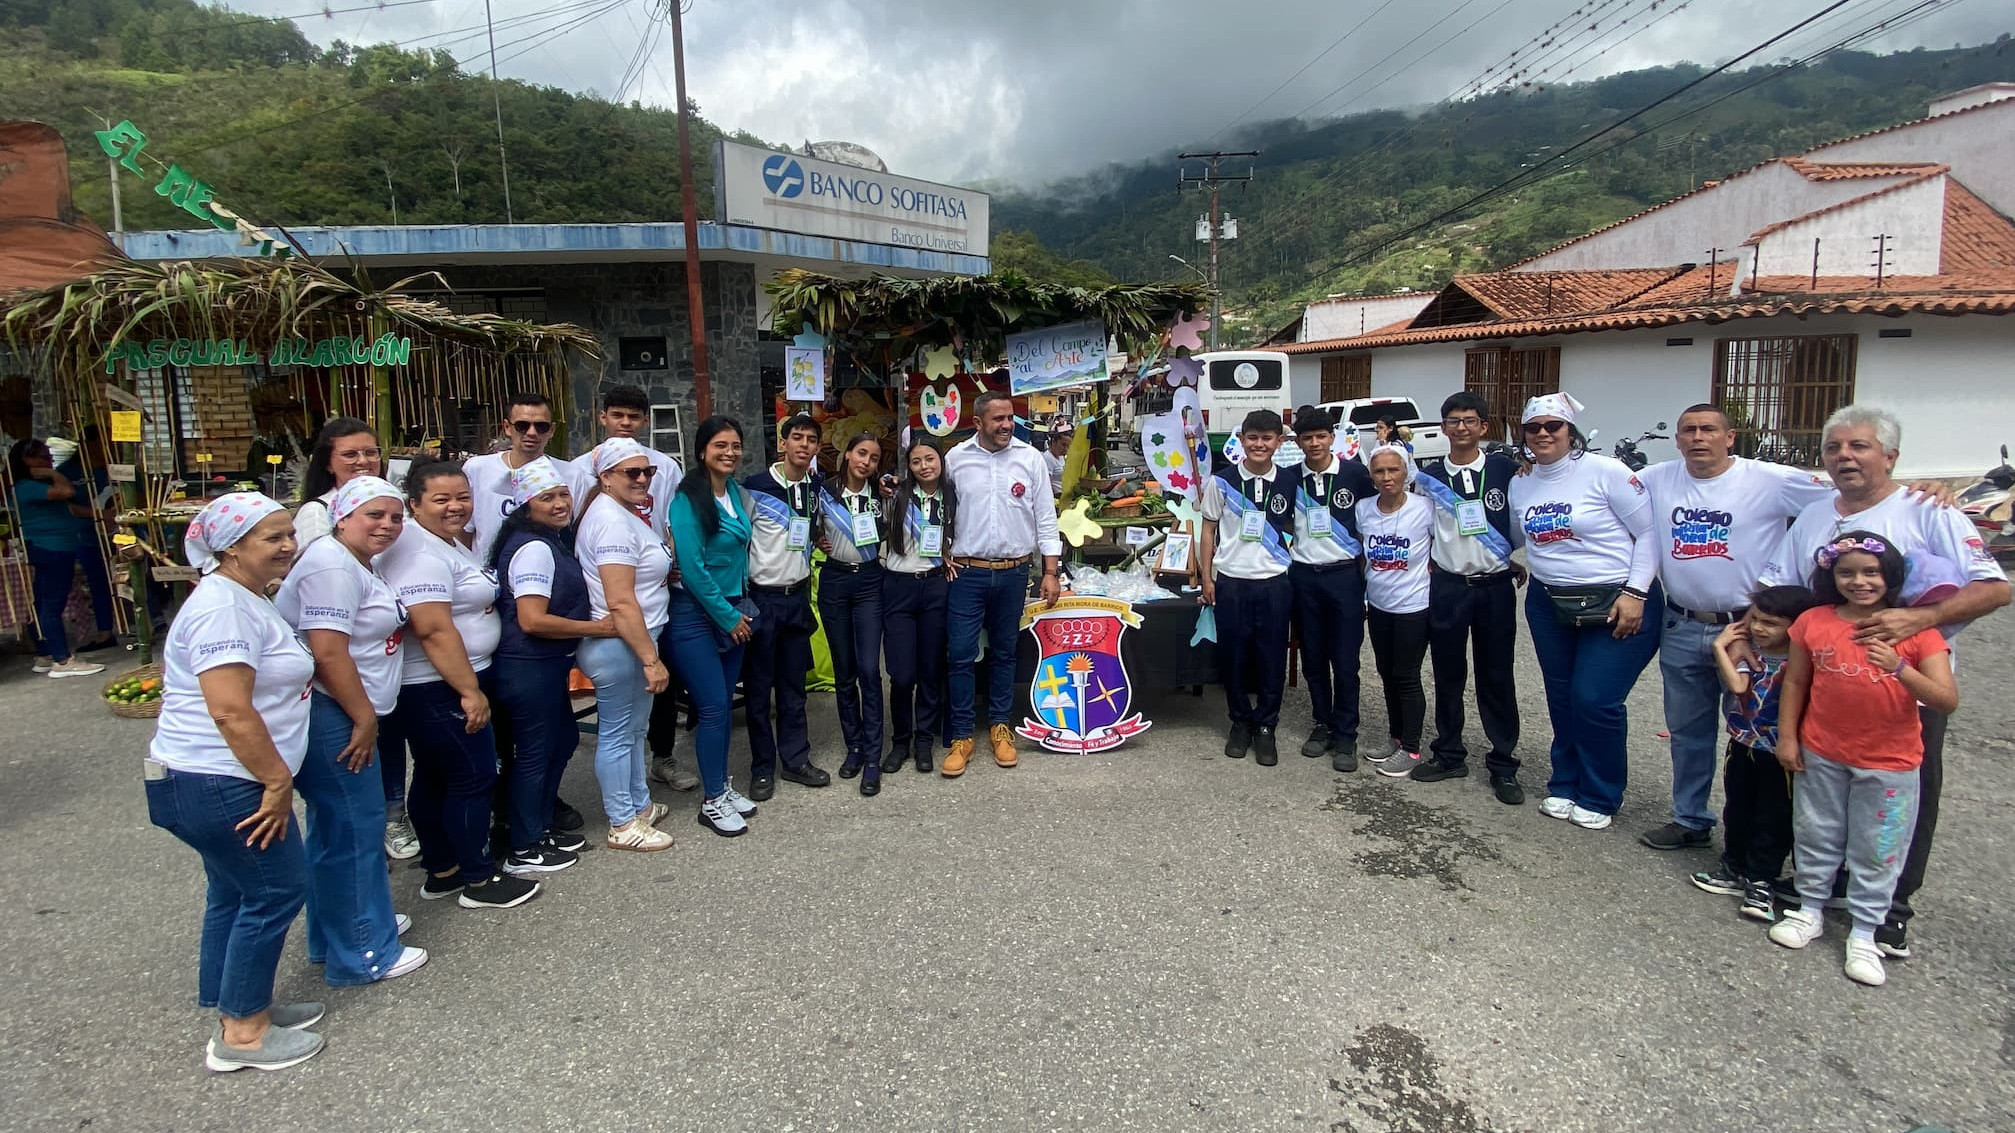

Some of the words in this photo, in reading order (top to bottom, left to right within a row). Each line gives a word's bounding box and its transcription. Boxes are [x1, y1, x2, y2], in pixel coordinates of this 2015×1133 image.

[810, 171, 884, 206] BANCO
[890, 186, 968, 221] SOFITASA
[891, 227, 924, 247] Banco
[926, 234, 968, 252] Universal
[103, 338, 258, 374] PASCUAL
[1016, 341, 1046, 362] Del
[1051, 335, 1092, 354] Campo
[1019, 360, 1033, 374] al
[1044, 351, 1084, 371] Arte
[1555, 515, 1571, 528] de
[1709, 525, 1729, 541] de
[1394, 548, 1409, 560] de
